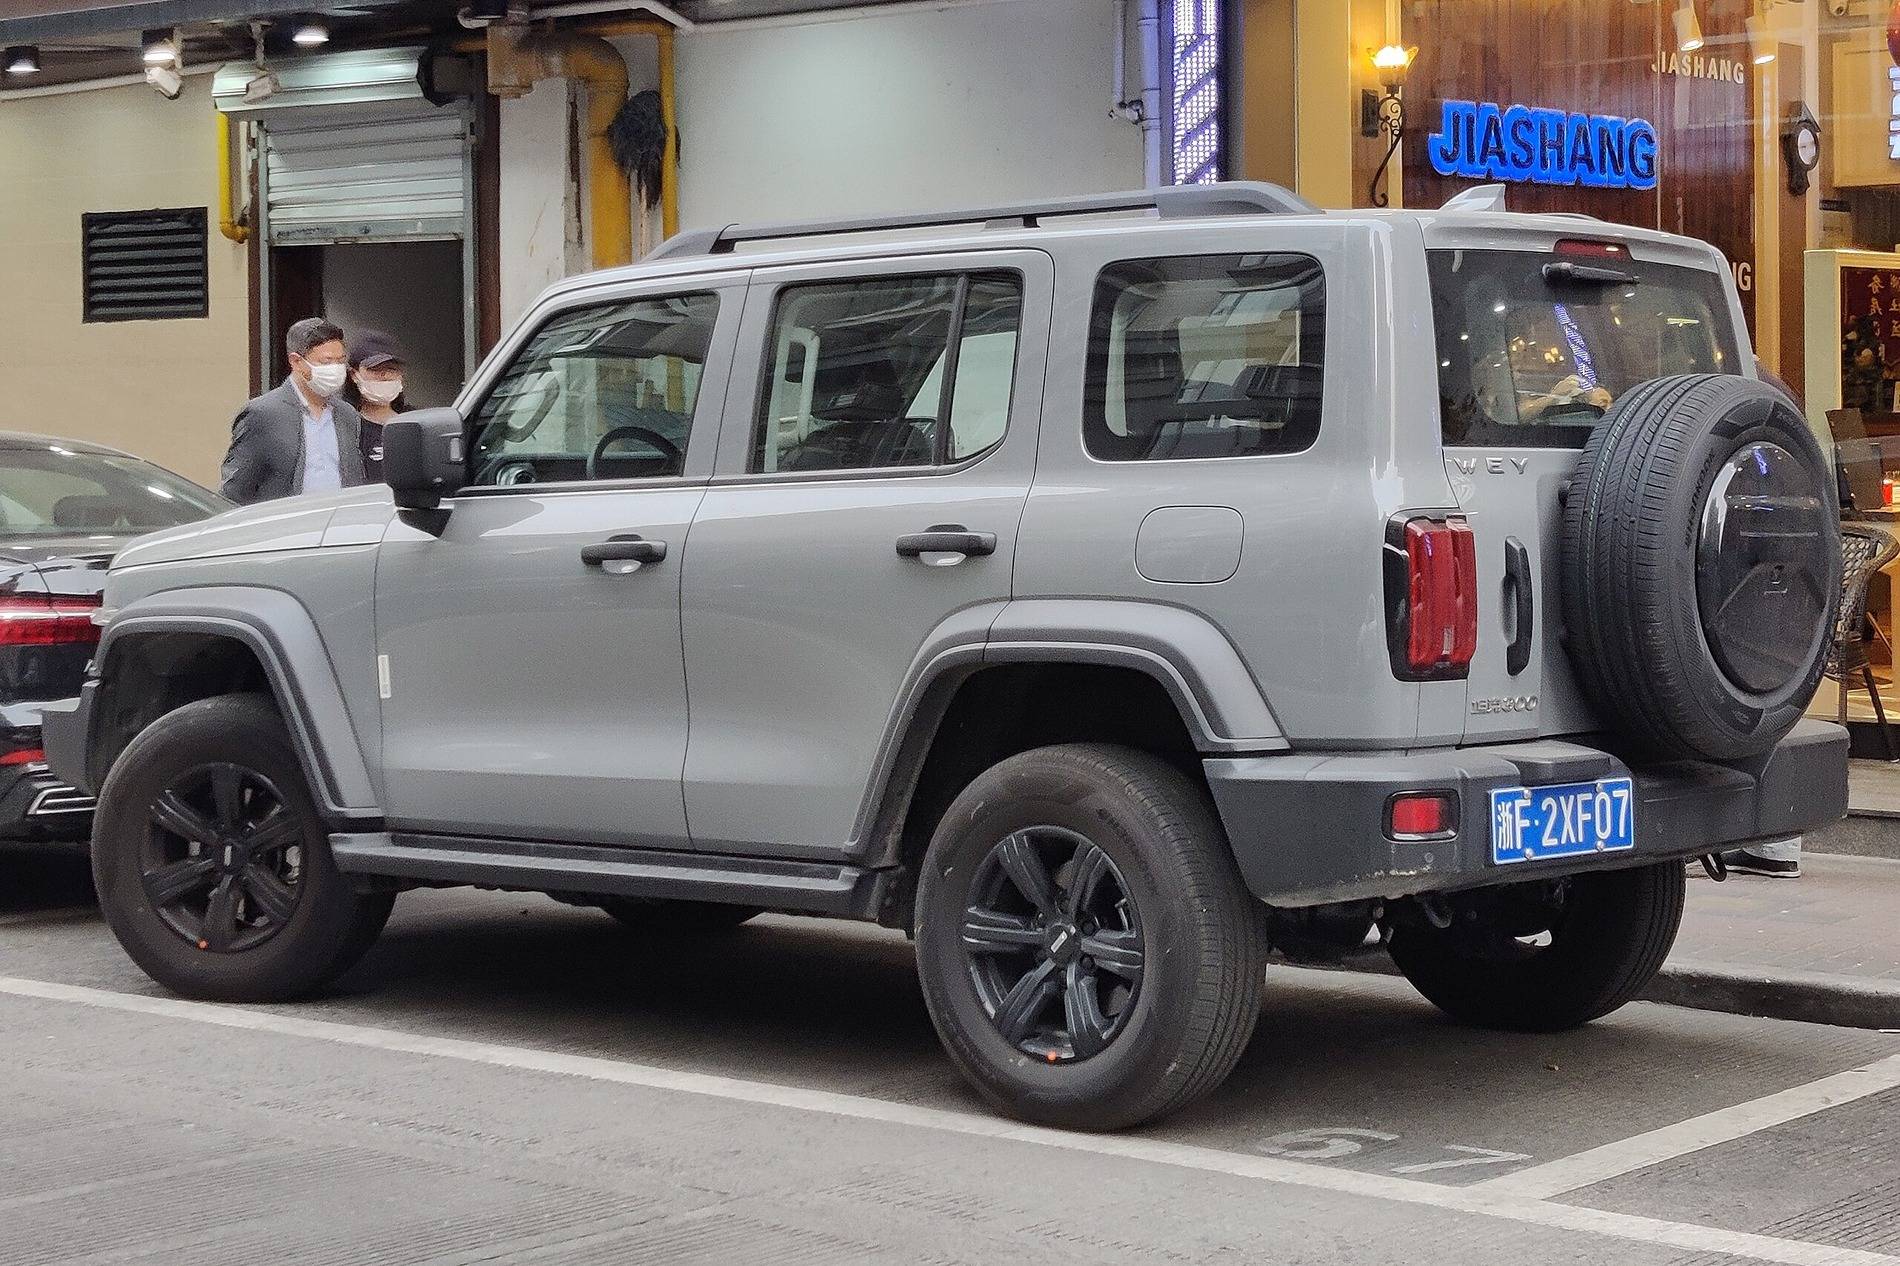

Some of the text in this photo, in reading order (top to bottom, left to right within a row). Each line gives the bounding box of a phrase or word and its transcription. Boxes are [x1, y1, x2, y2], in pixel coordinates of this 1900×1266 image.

[1650, 51, 1744, 84] JIASHANG
[1436, 106, 1657, 183] JIASHANG
[1452, 456, 1529, 475] WEY
